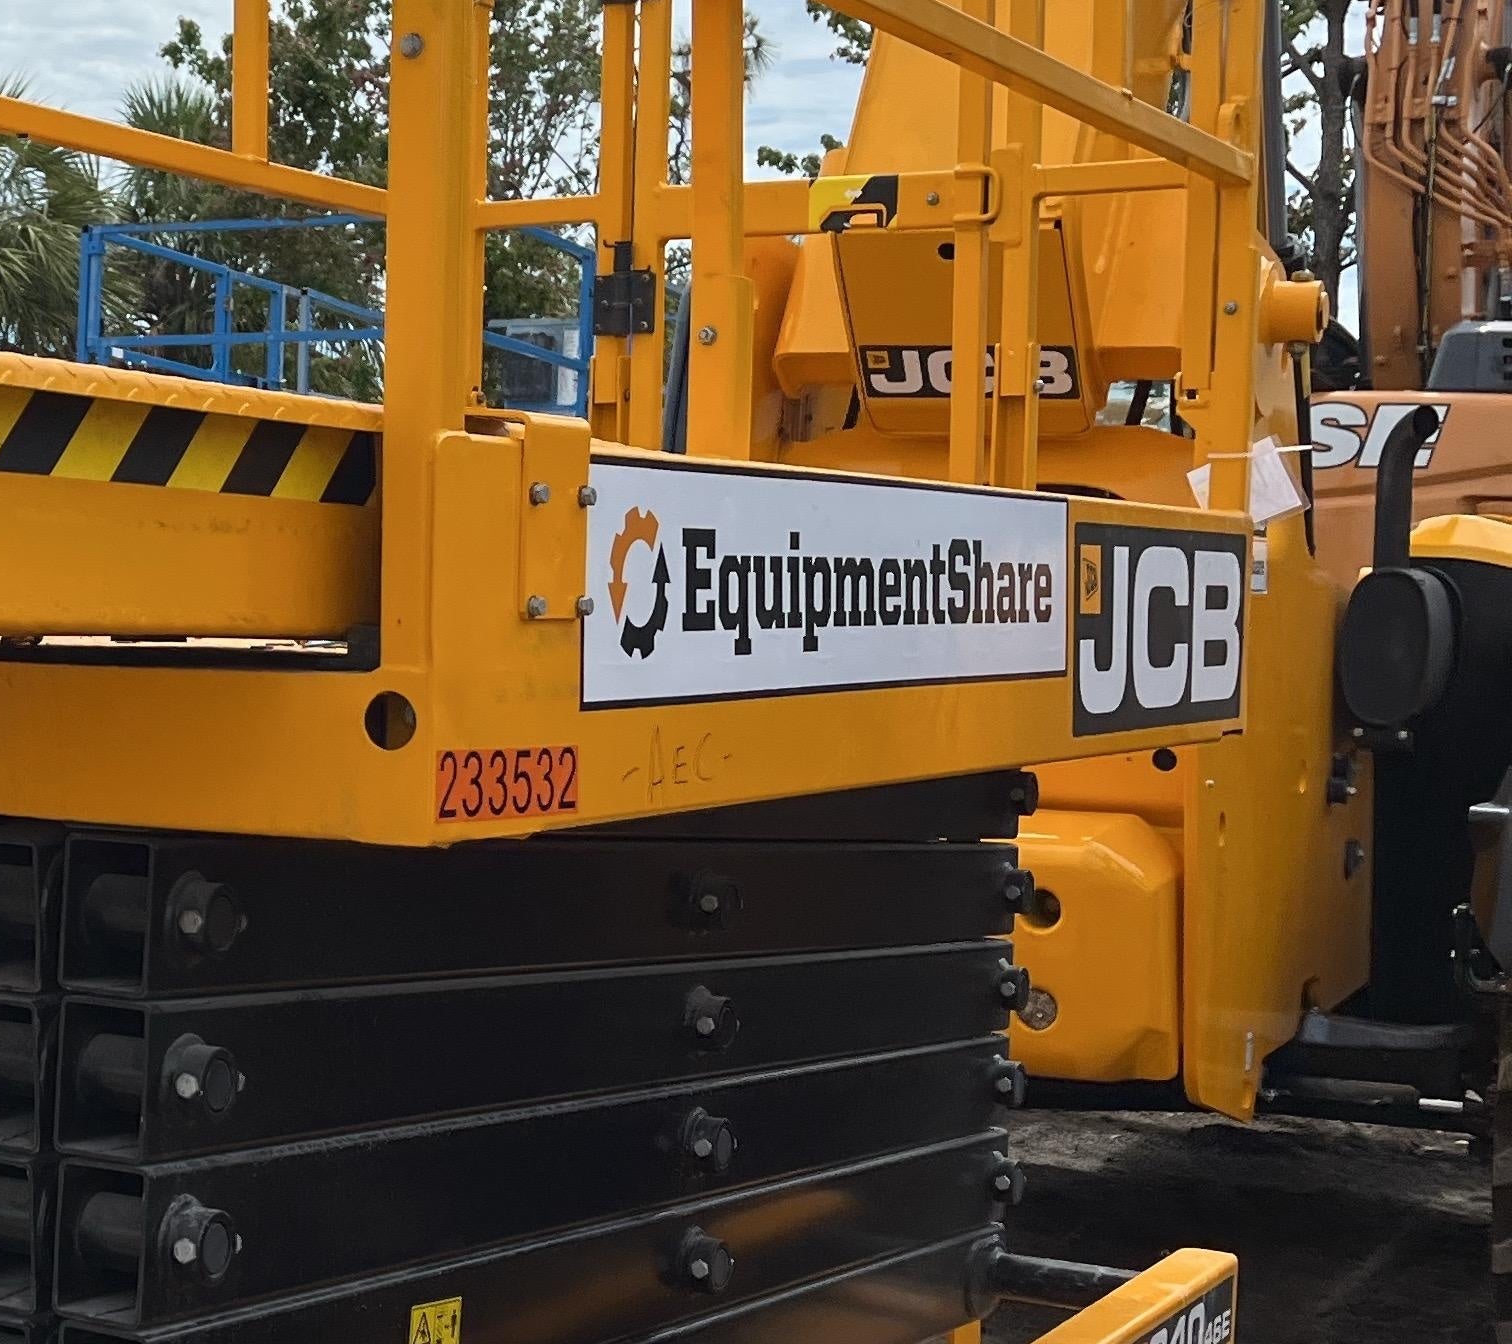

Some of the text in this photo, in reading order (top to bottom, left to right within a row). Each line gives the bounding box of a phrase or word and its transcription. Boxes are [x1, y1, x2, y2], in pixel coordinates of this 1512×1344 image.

[682, 528, 1053, 656] EquipmentShare
[1081, 544, 1242, 716] JCB
[436, 747, 579, 820] 233532
